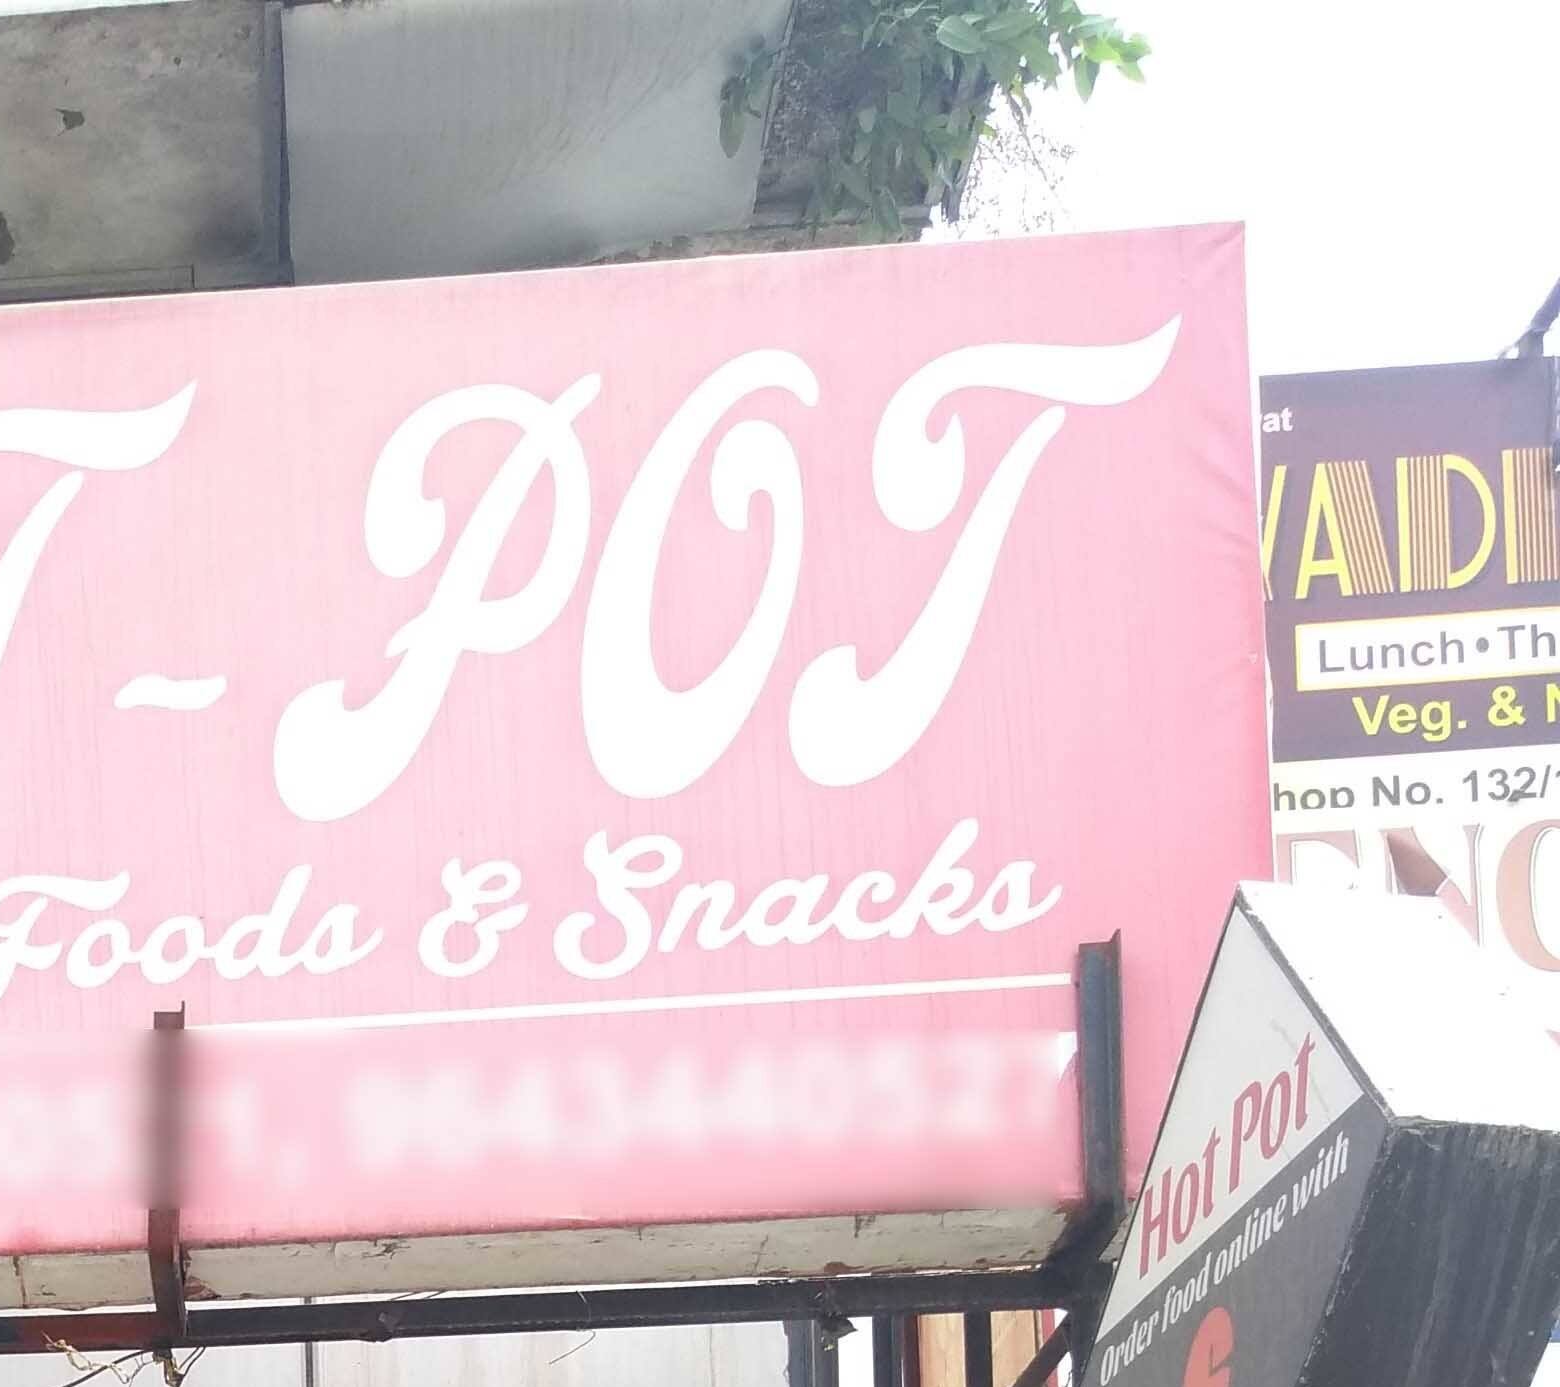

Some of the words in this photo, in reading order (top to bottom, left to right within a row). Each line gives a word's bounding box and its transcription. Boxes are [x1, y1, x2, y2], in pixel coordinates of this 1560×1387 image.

[273, 312, 1182, 822] POT
[1351, 694, 1468, 742] Veg.
[1487, 684, 1527, 727] &
[1371, 774, 1444, 807] No.
[417, 857, 530, 978] &
[553, 818, 1062, 979] Snacks
[1099, 1309, 1160, 1387] Order
[1161, 1262, 1212, 1341] food
[1213, 1195, 1288, 1288] online
[1290, 1131, 1351, 1218] with
[1139, 1126, 1220, 1282] Hot
[1228, 1031, 1317, 1195] Pot
